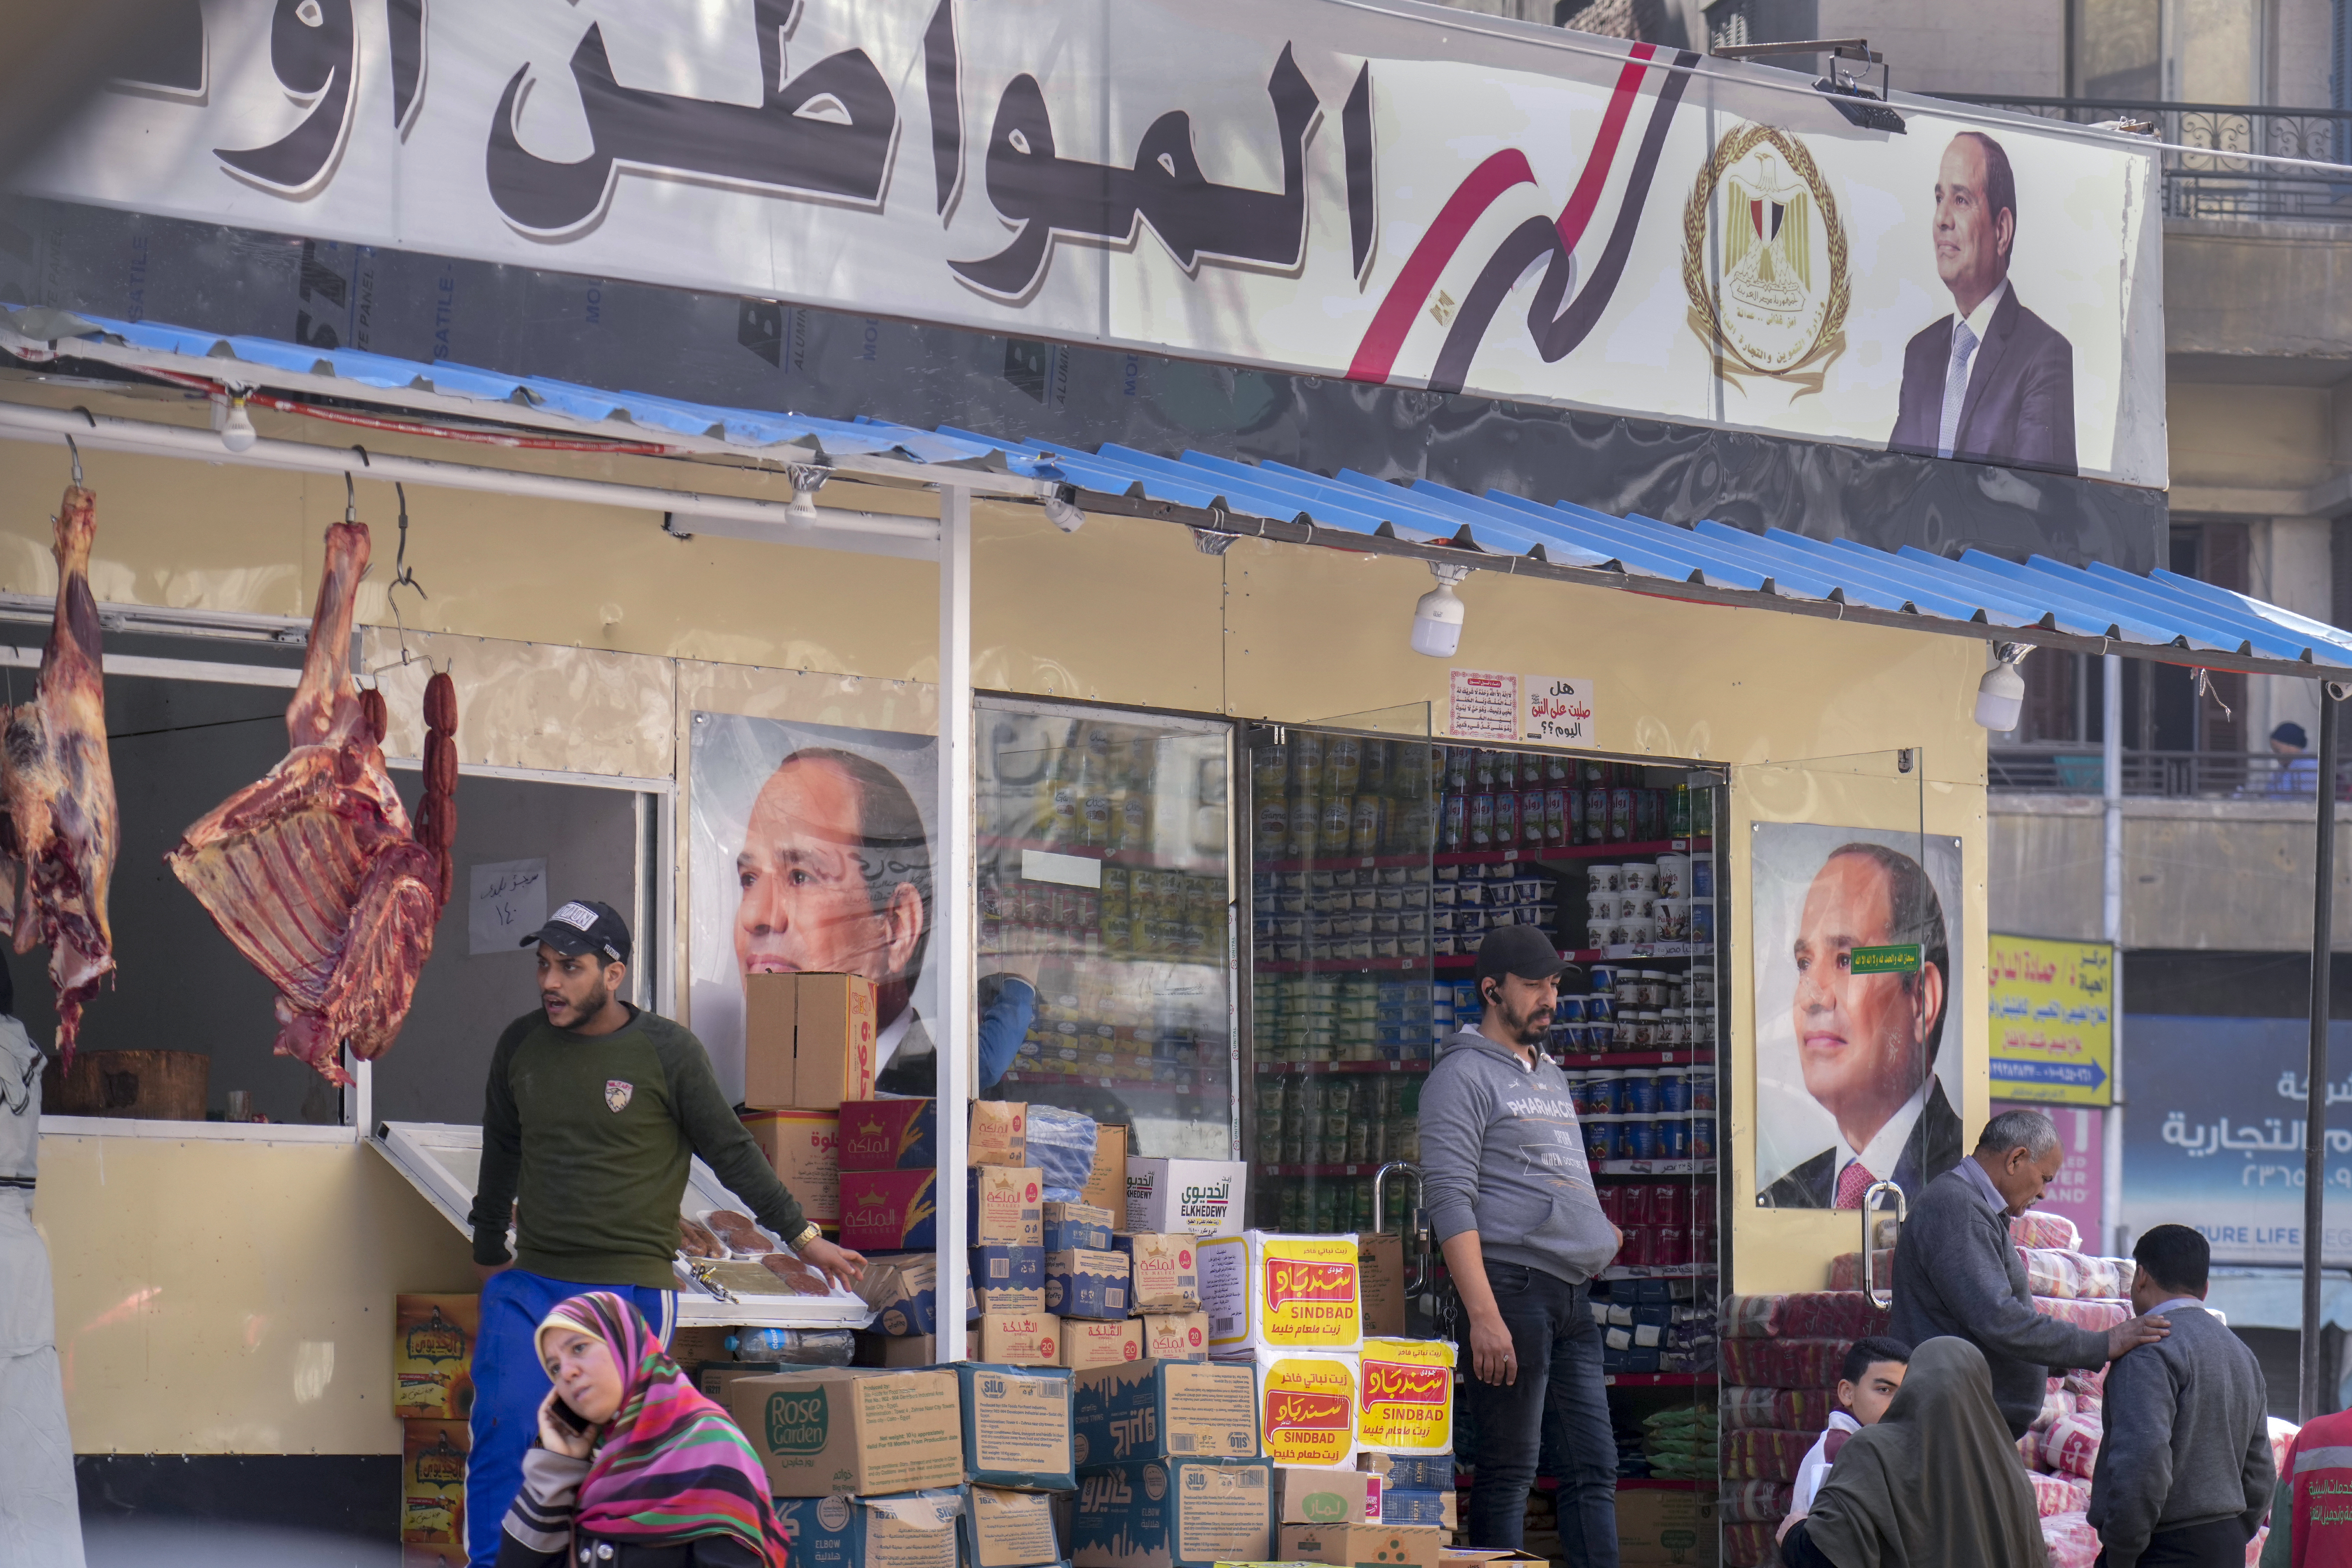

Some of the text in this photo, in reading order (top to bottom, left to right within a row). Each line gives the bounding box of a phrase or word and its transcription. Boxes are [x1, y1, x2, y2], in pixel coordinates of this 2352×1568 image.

[487, 0, 1378, 300] المواطن
[1550, 681, 1574, 696] هل
[1550, 699, 1566, 719] على
[1568, 701, 1590, 720] صليت
[1555, 722, 1582, 738] اليوم
[1261, 809, 1286, 820] Ganna
[1884, 954, 1896, 965] والحمد
[1904, 953, 1914, 965] سبحان
[979, 1123, 1008, 1133] الملكة
[848, 1137, 889, 1153] الملكة
[1541, 1153, 1562, 1166] WHEN
[1562, 1156, 1583, 1170] DOCTORS
[987, 1191, 1020, 1203] الملكة
[1181, 1205, 1227, 1218] ELKHEDEWY
[845, 1209, 895, 1227] الملكة
[2194, 1226, 2248, 1242] PURE
[2256, 1228, 2300, 1244] LIFE
[1140, 1258, 1175, 1270] الملكة
[1292, 1307, 1353, 1319] SINDBAD
[1003, 1322, 1037, 1333] الملكة
[1088, 1325, 1122, 1337] الملكة
[1272, 1324, 1340, 1338] زيت طعام خليط
[1153, 1337, 1184, 1349] الملكة
[1412, 1349, 1425, 1358] نباتي
[984, 1380, 1003, 1393] SILO
[1281, 1373, 1347, 1388] زيت نباتي فاخر
[772, 1397, 821, 1426] Rose
[1383, 1409, 1443, 1421] SINDBAD
[773, 1425, 823, 1445] Garden
[1363, 1425, 1430, 1438] زيت طعام خليط
[1230, 1437, 1247, 1449] SILO
[1284, 1432, 1335, 1444] SINDBAD
[1274, 1449, 1339, 1460] زيت طعام خليط
[804, 1459, 814, 1468] روز
[833, 1468, 853, 1481] خواتم
[1188, 1473, 1204, 1485] SILO
[1309, 1500, 1340, 1517] لمار
[1141, 1520, 1160, 1529] هلالية
[815, 1540, 840, 1549] ELBOW
[815, 1552, 840, 1562] هلالية
